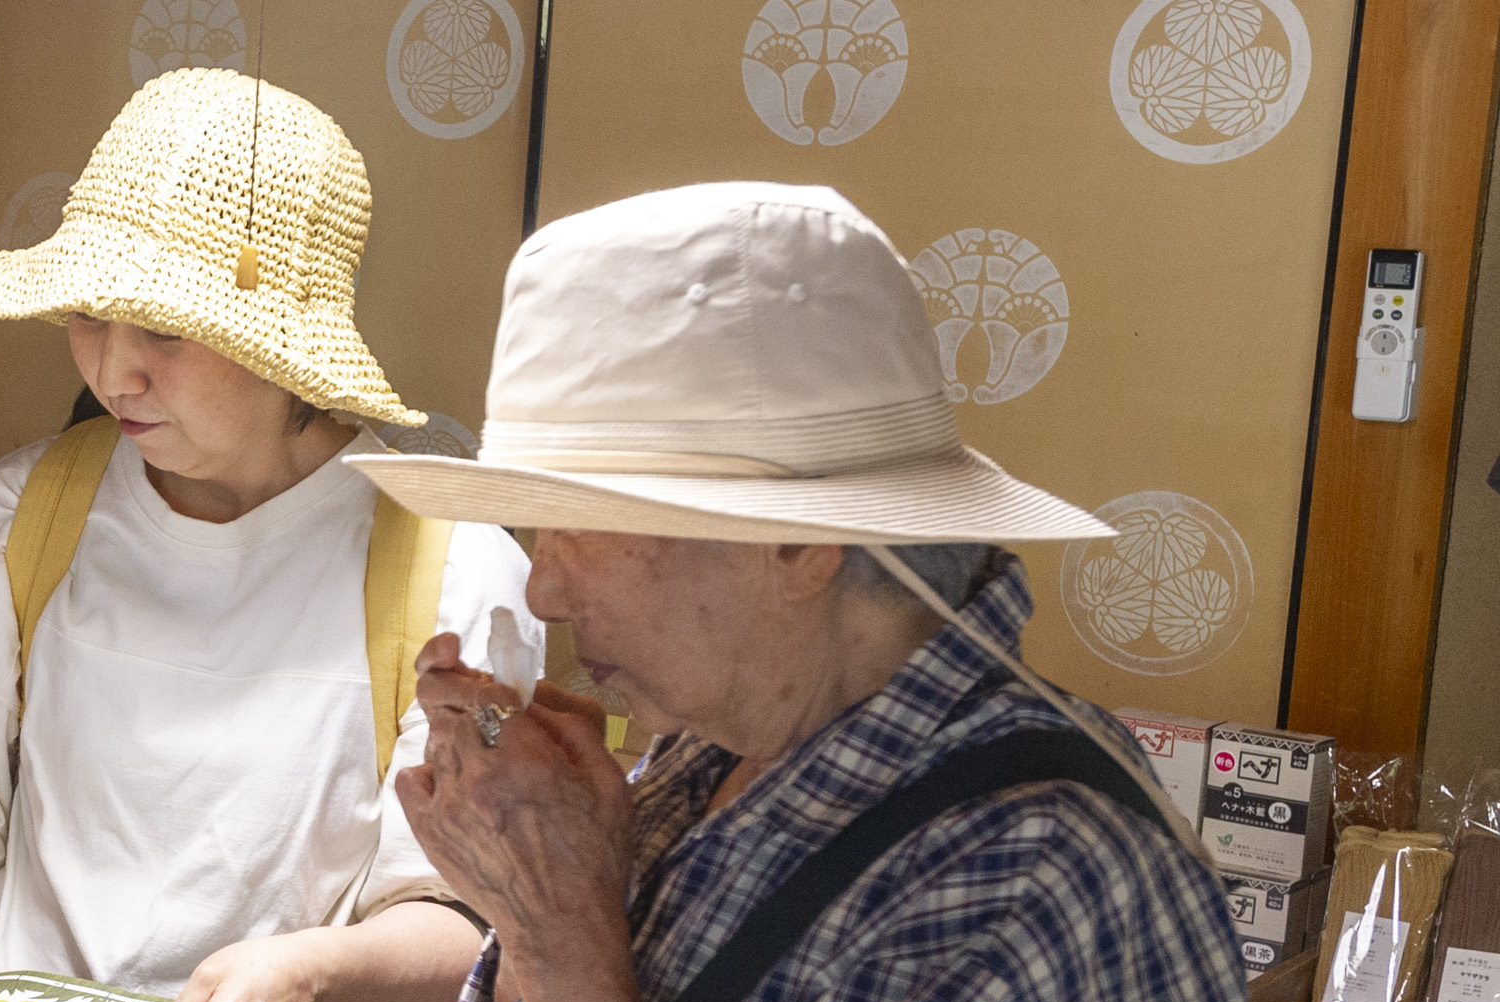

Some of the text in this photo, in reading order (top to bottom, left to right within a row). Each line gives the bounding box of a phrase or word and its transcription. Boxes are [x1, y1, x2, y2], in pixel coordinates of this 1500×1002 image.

[1137, 731, 1172, 752] ヘナ
[1242, 758, 1278, 779] ヘナ
[1272, 806, 1287, 821] 黒
[1244, 945, 1272, 961] 黒茶
